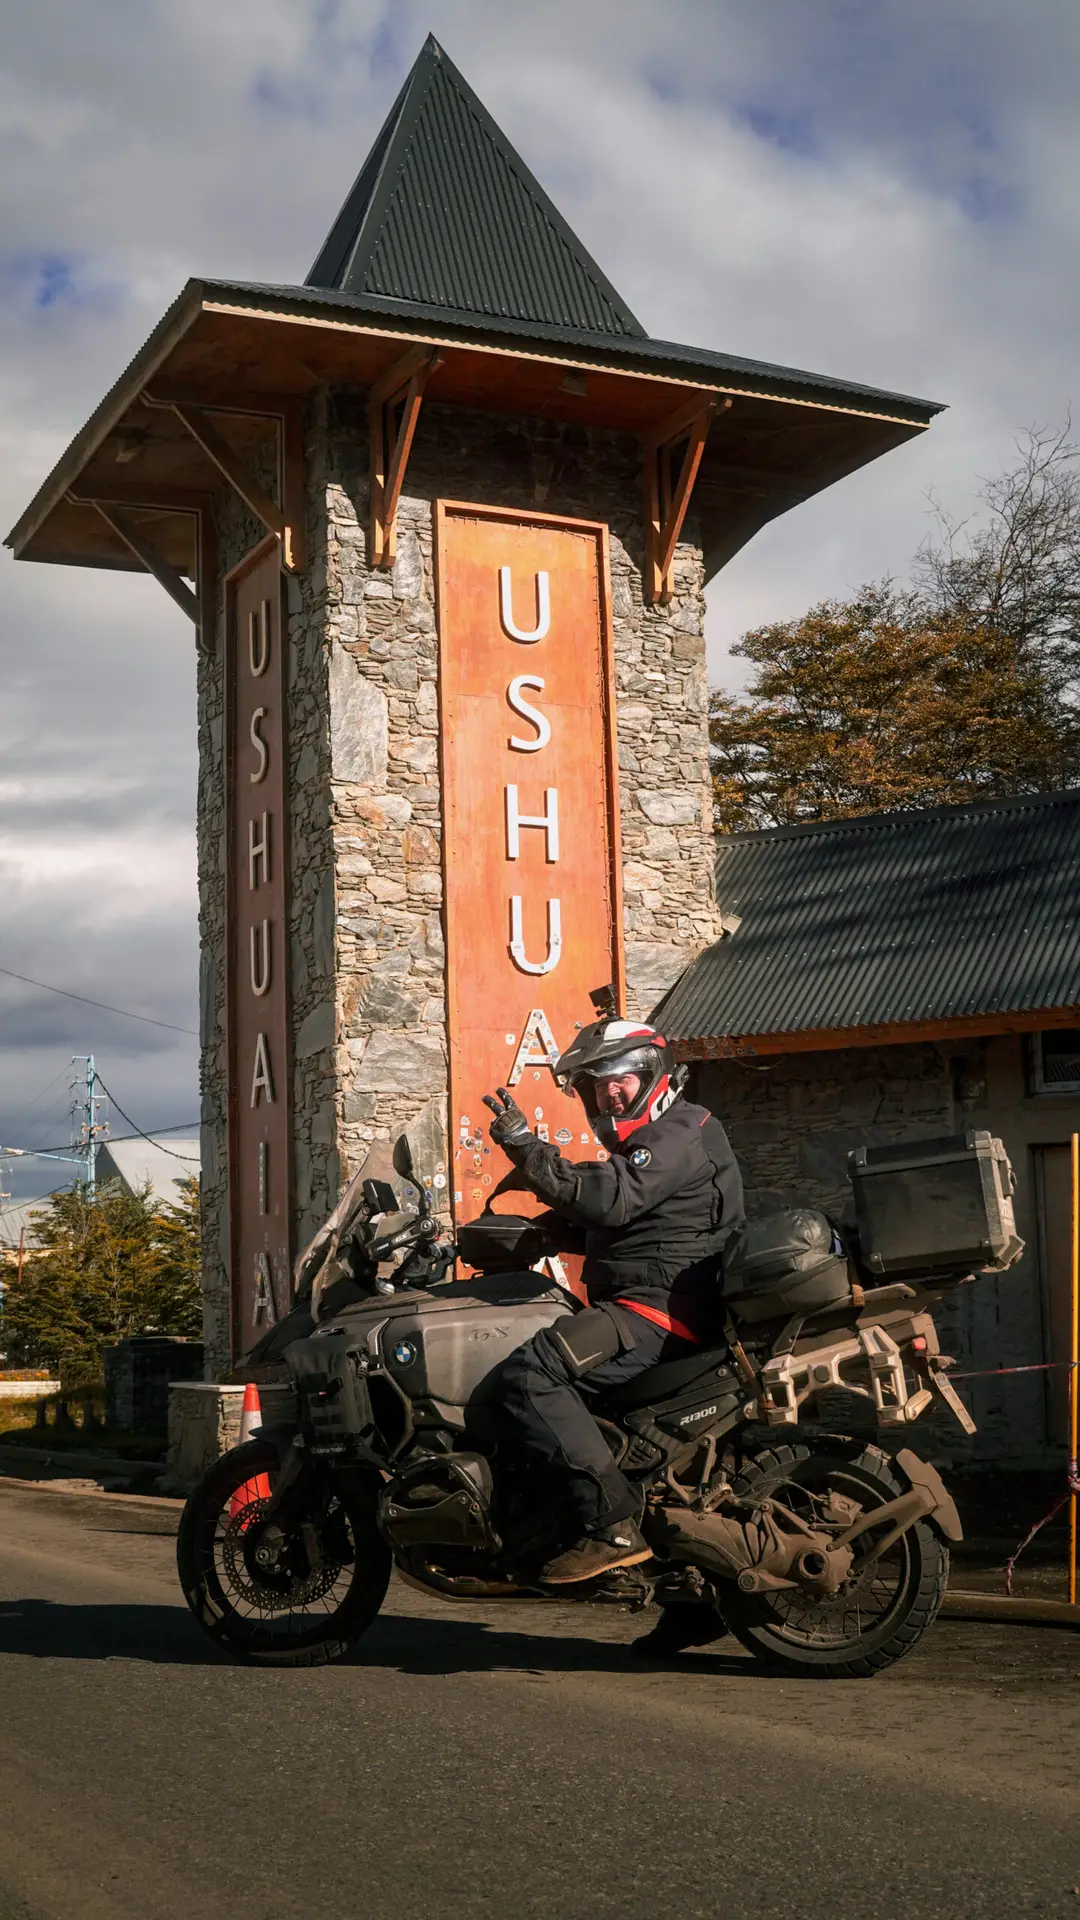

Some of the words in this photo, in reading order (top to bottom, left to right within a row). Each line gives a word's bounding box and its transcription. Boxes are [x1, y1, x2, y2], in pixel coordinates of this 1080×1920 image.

[248, 599, 275, 1327] USHUAIA
[500, 565, 573, 1293] USHUA
[679, 1405, 717, 1426] R1300
